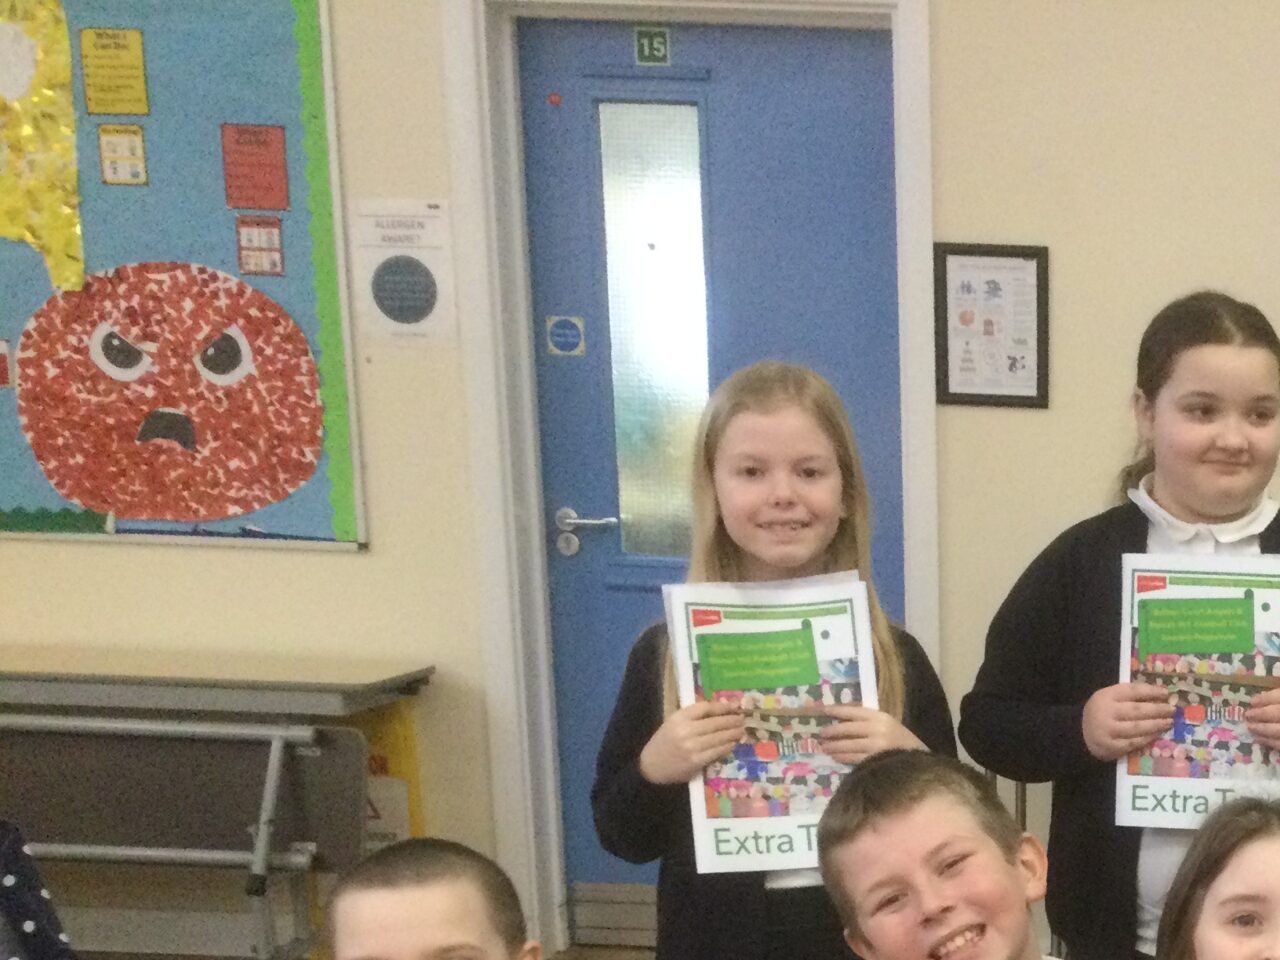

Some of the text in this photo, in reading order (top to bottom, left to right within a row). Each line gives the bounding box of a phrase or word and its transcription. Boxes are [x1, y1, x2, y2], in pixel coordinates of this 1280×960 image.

[640, 37, 665, 58] 15
[1131, 784, 1209, 814] Extra
[713, 827, 794, 855] Extra
